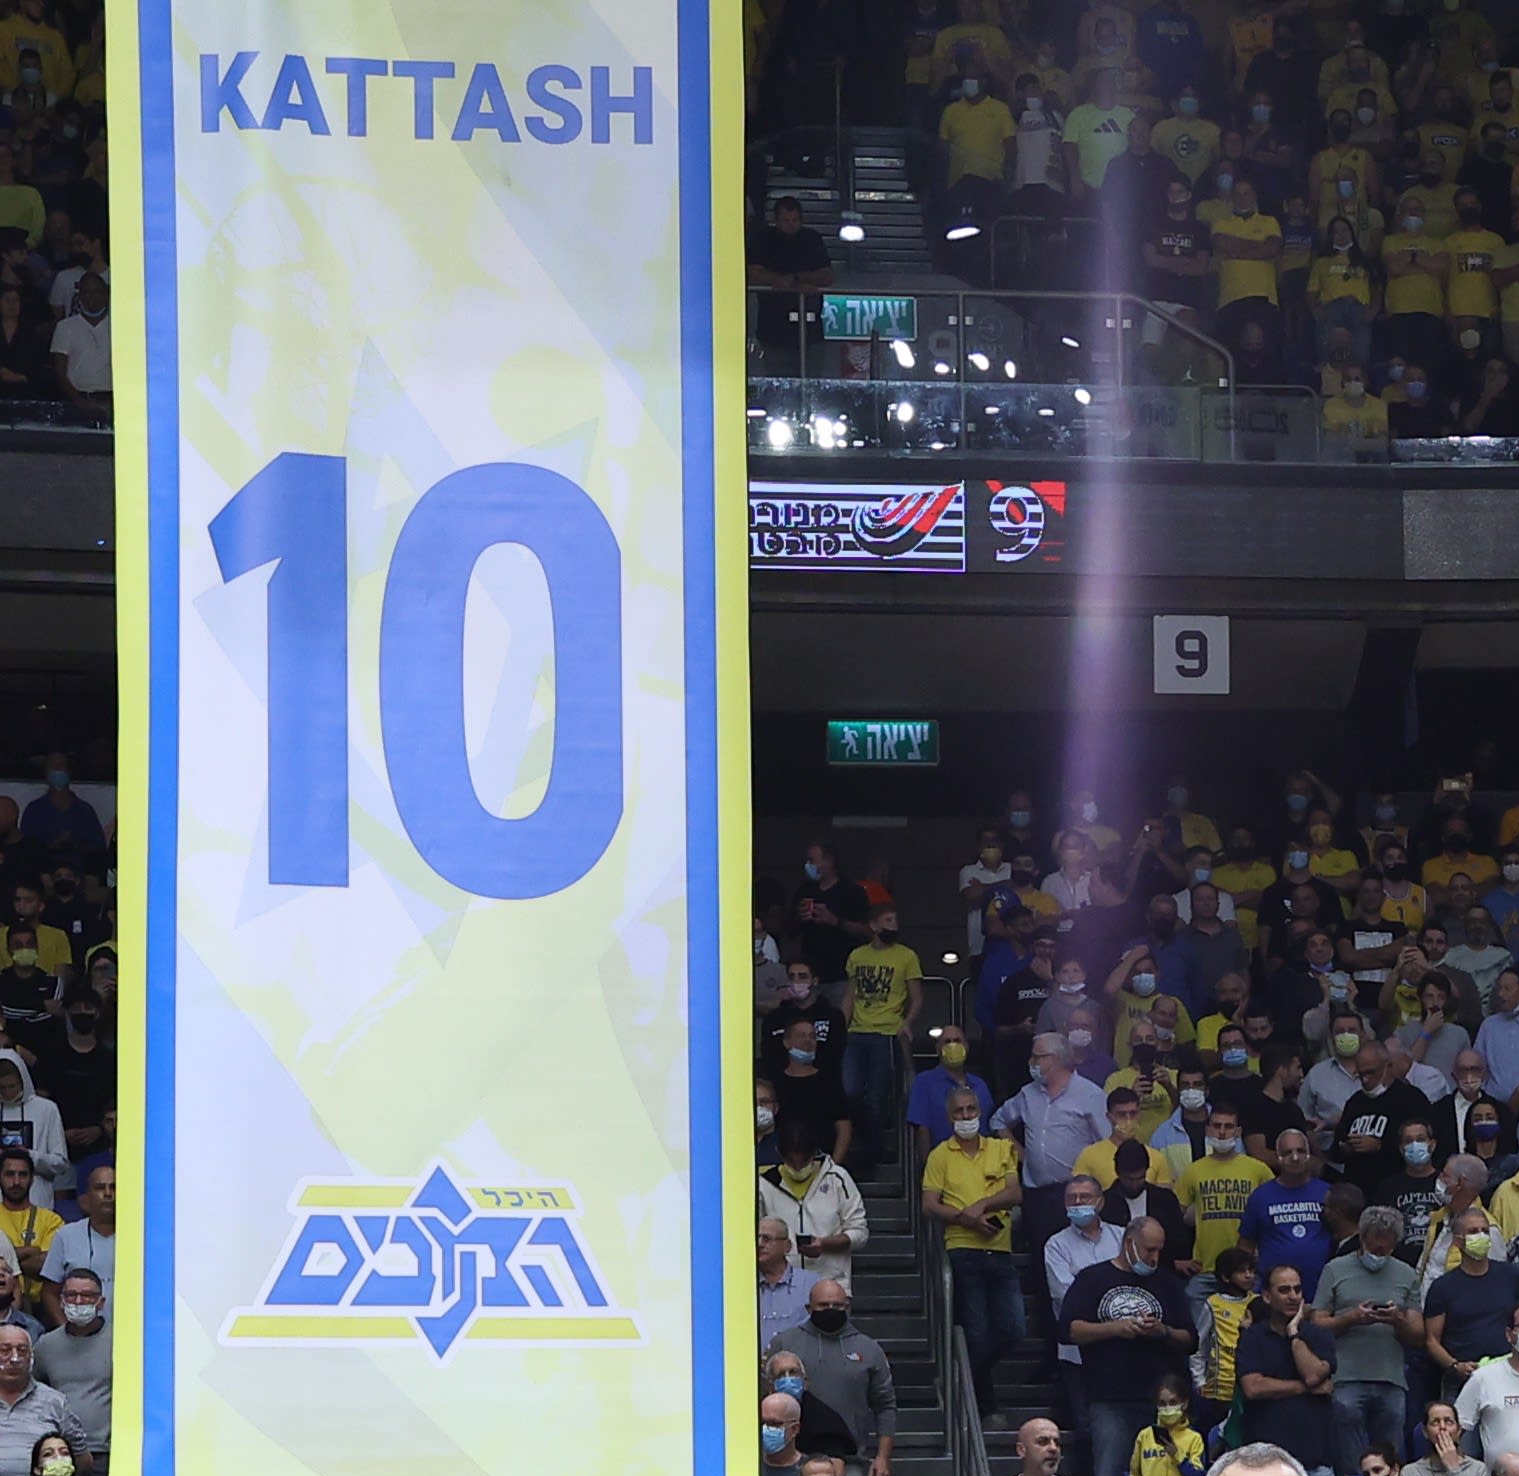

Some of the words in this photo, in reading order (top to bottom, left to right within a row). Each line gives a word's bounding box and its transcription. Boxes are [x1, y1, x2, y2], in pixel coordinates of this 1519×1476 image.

[199, 51, 654, 144] KATTASH
[846, 300, 906, 335] יציאה
[989, 486, 1044, 562] 9
[1175, 630, 1208, 678] 9
[207, 452, 624, 900] 10
[866, 724, 929, 760] יציאה
[1348, 1114, 1389, 1138] POLO
[482, 1187, 559, 1207] היכל
[1199, 1179, 1252, 1196] MACCABI
[1202, 1195, 1221, 1211] TEL
[1273, 1212, 1320, 1224] BASKETBALL
